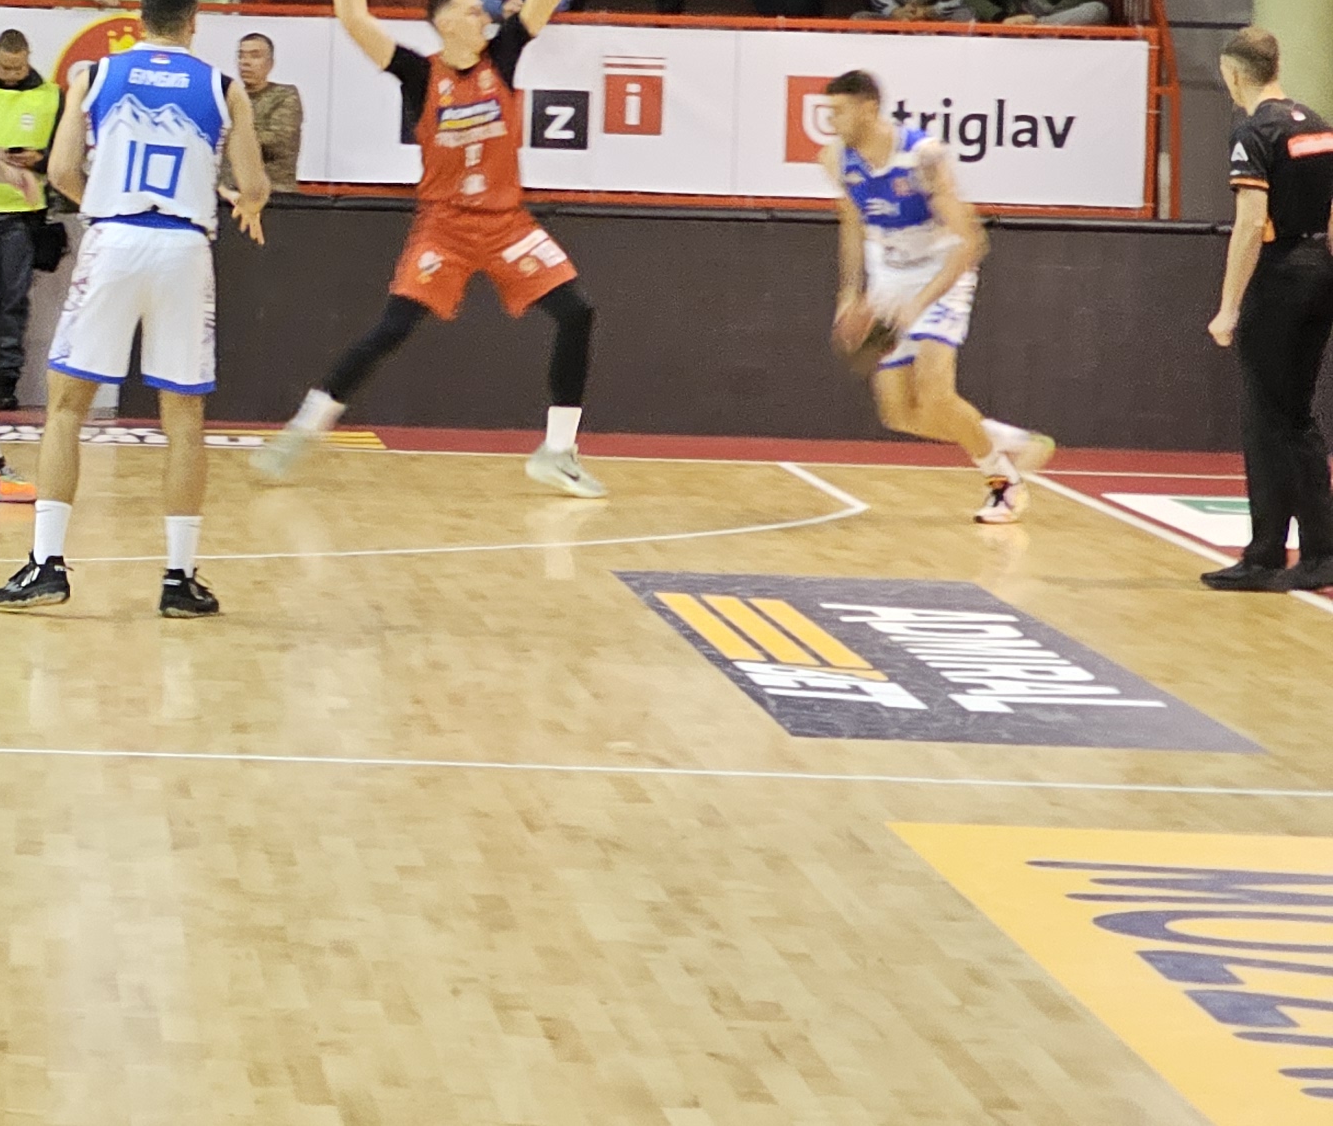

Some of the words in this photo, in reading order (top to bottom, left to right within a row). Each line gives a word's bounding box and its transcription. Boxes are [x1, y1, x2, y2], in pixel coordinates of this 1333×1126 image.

[890, 97, 1077, 164] triglav
[123, 139, 187, 199] 10
[819, 602, 1168, 714] ADMIRAL
